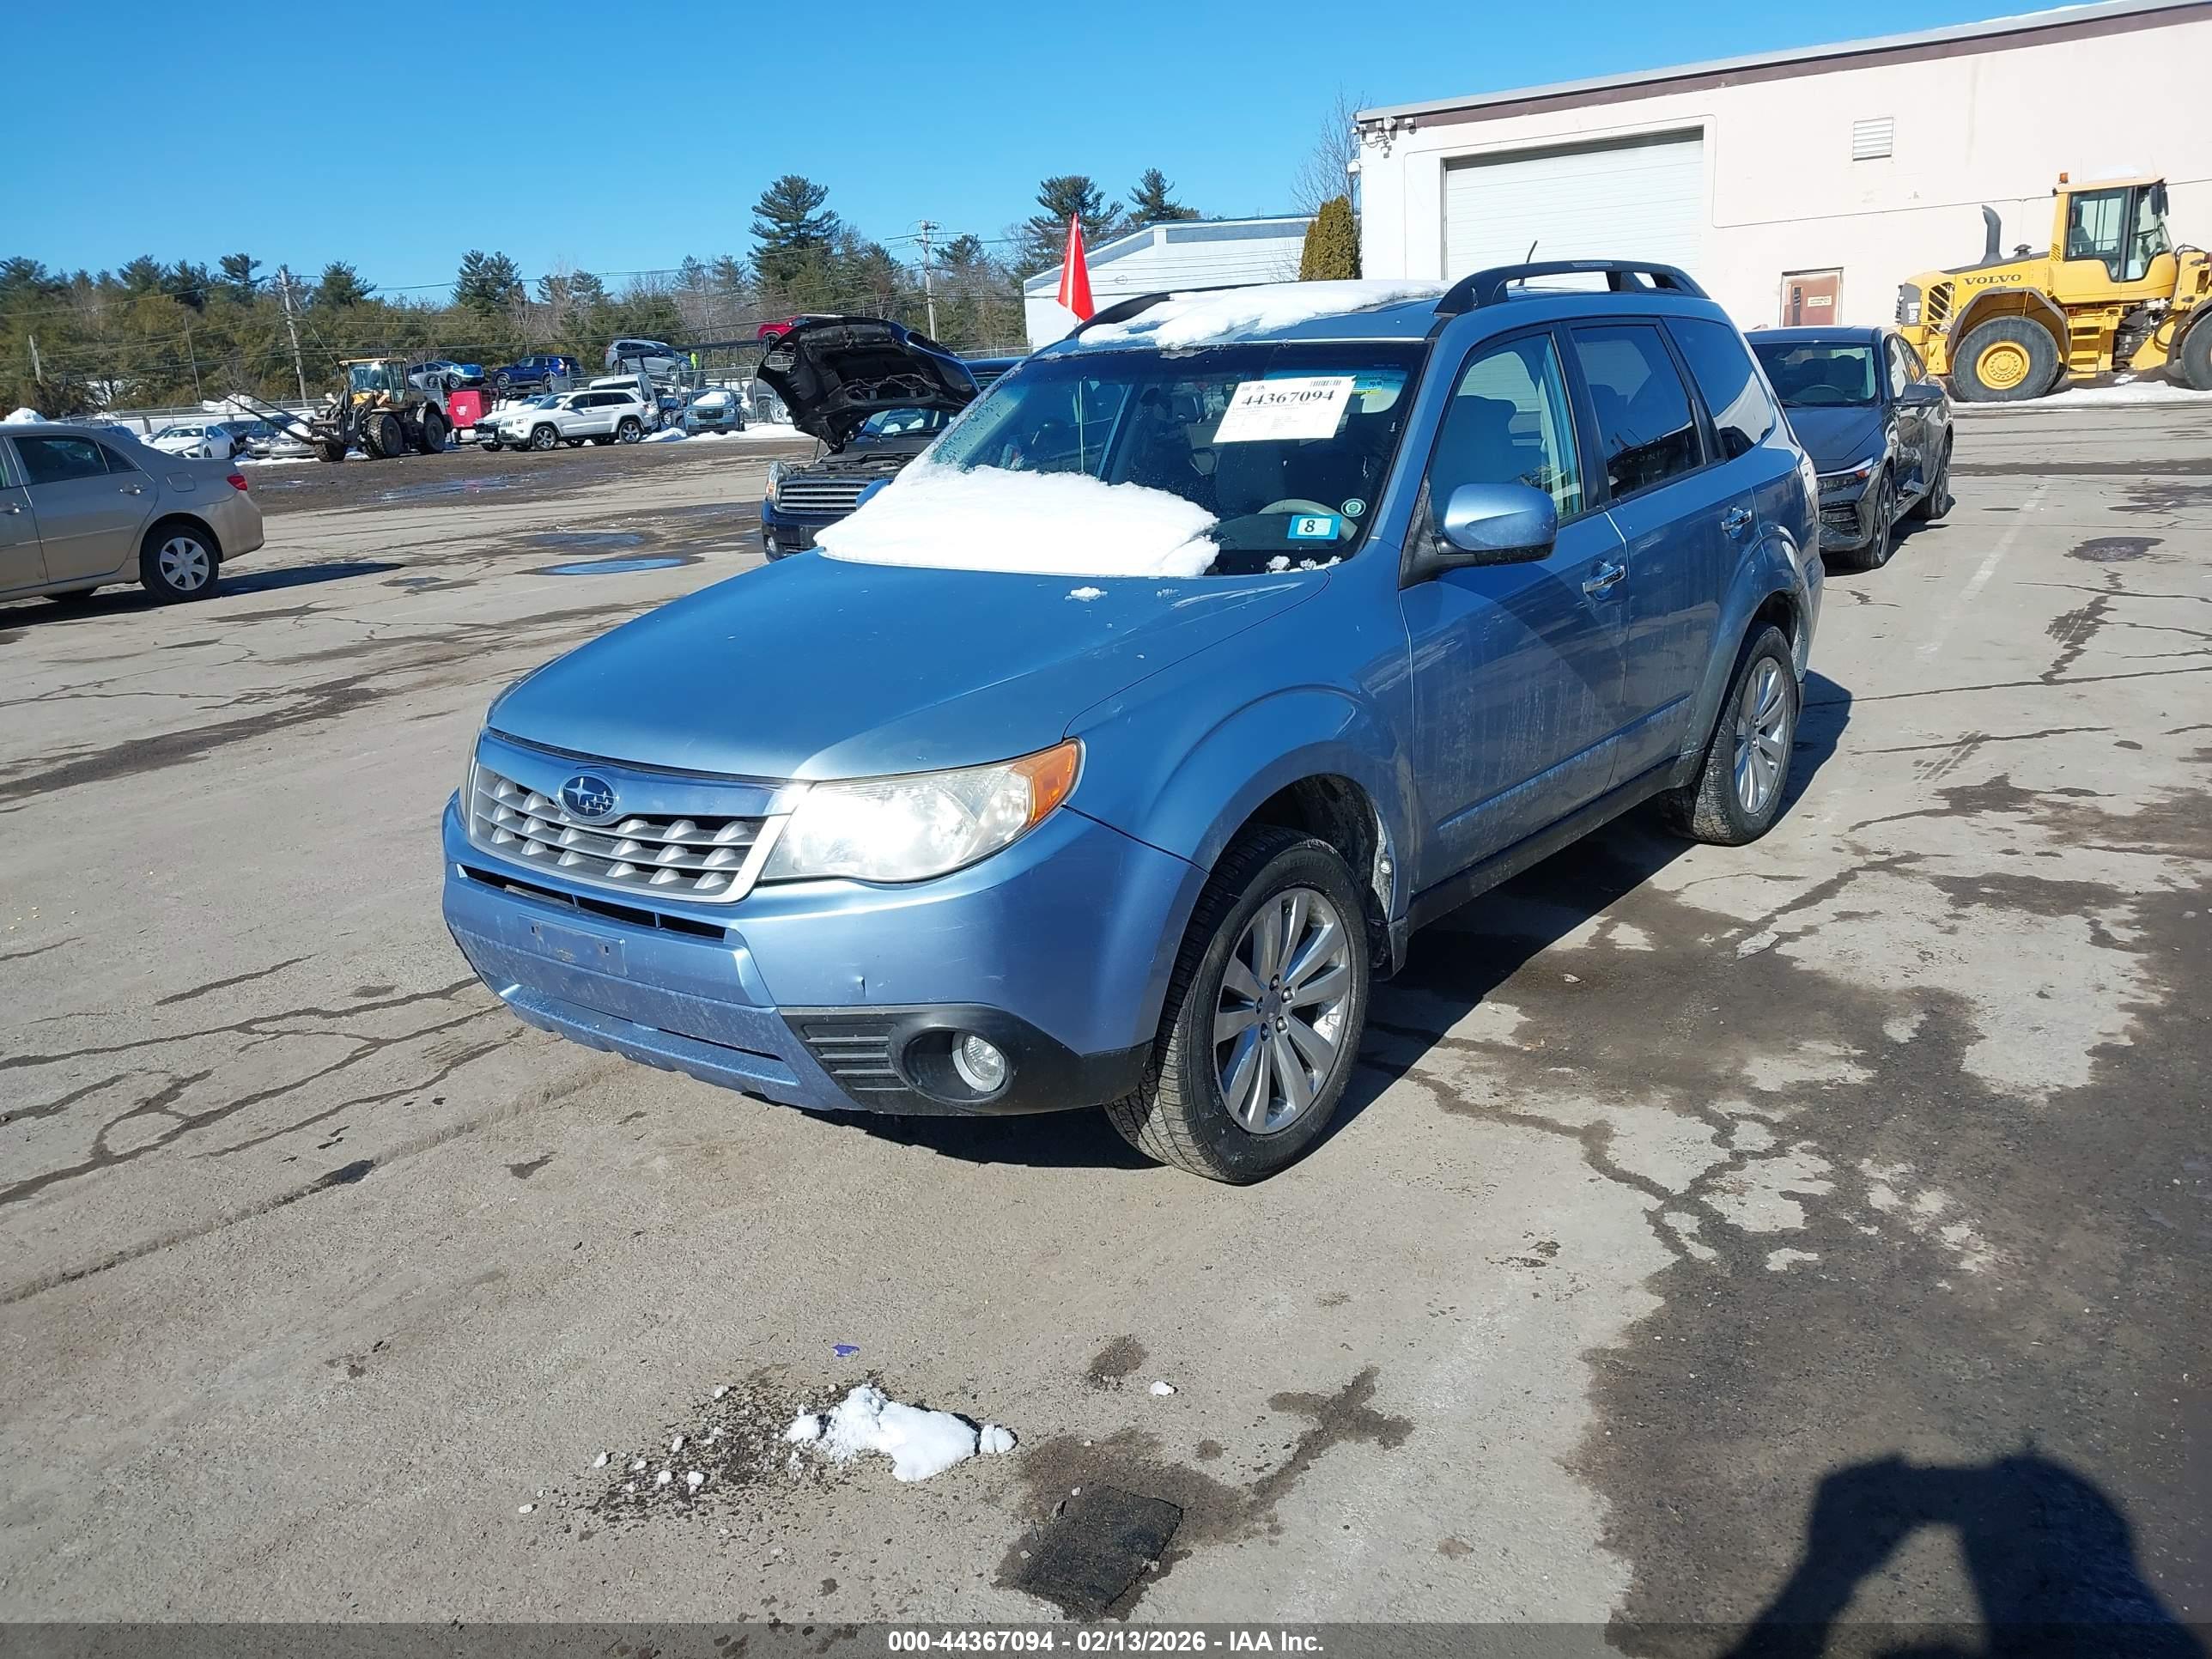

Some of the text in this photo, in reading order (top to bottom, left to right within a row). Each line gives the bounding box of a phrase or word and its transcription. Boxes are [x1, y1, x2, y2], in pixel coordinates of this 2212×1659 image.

[1963, 274, 2022, 285] VOLVO
[1243, 390, 1334, 405] 44367094
[1304, 520, 1316, 532] 8
